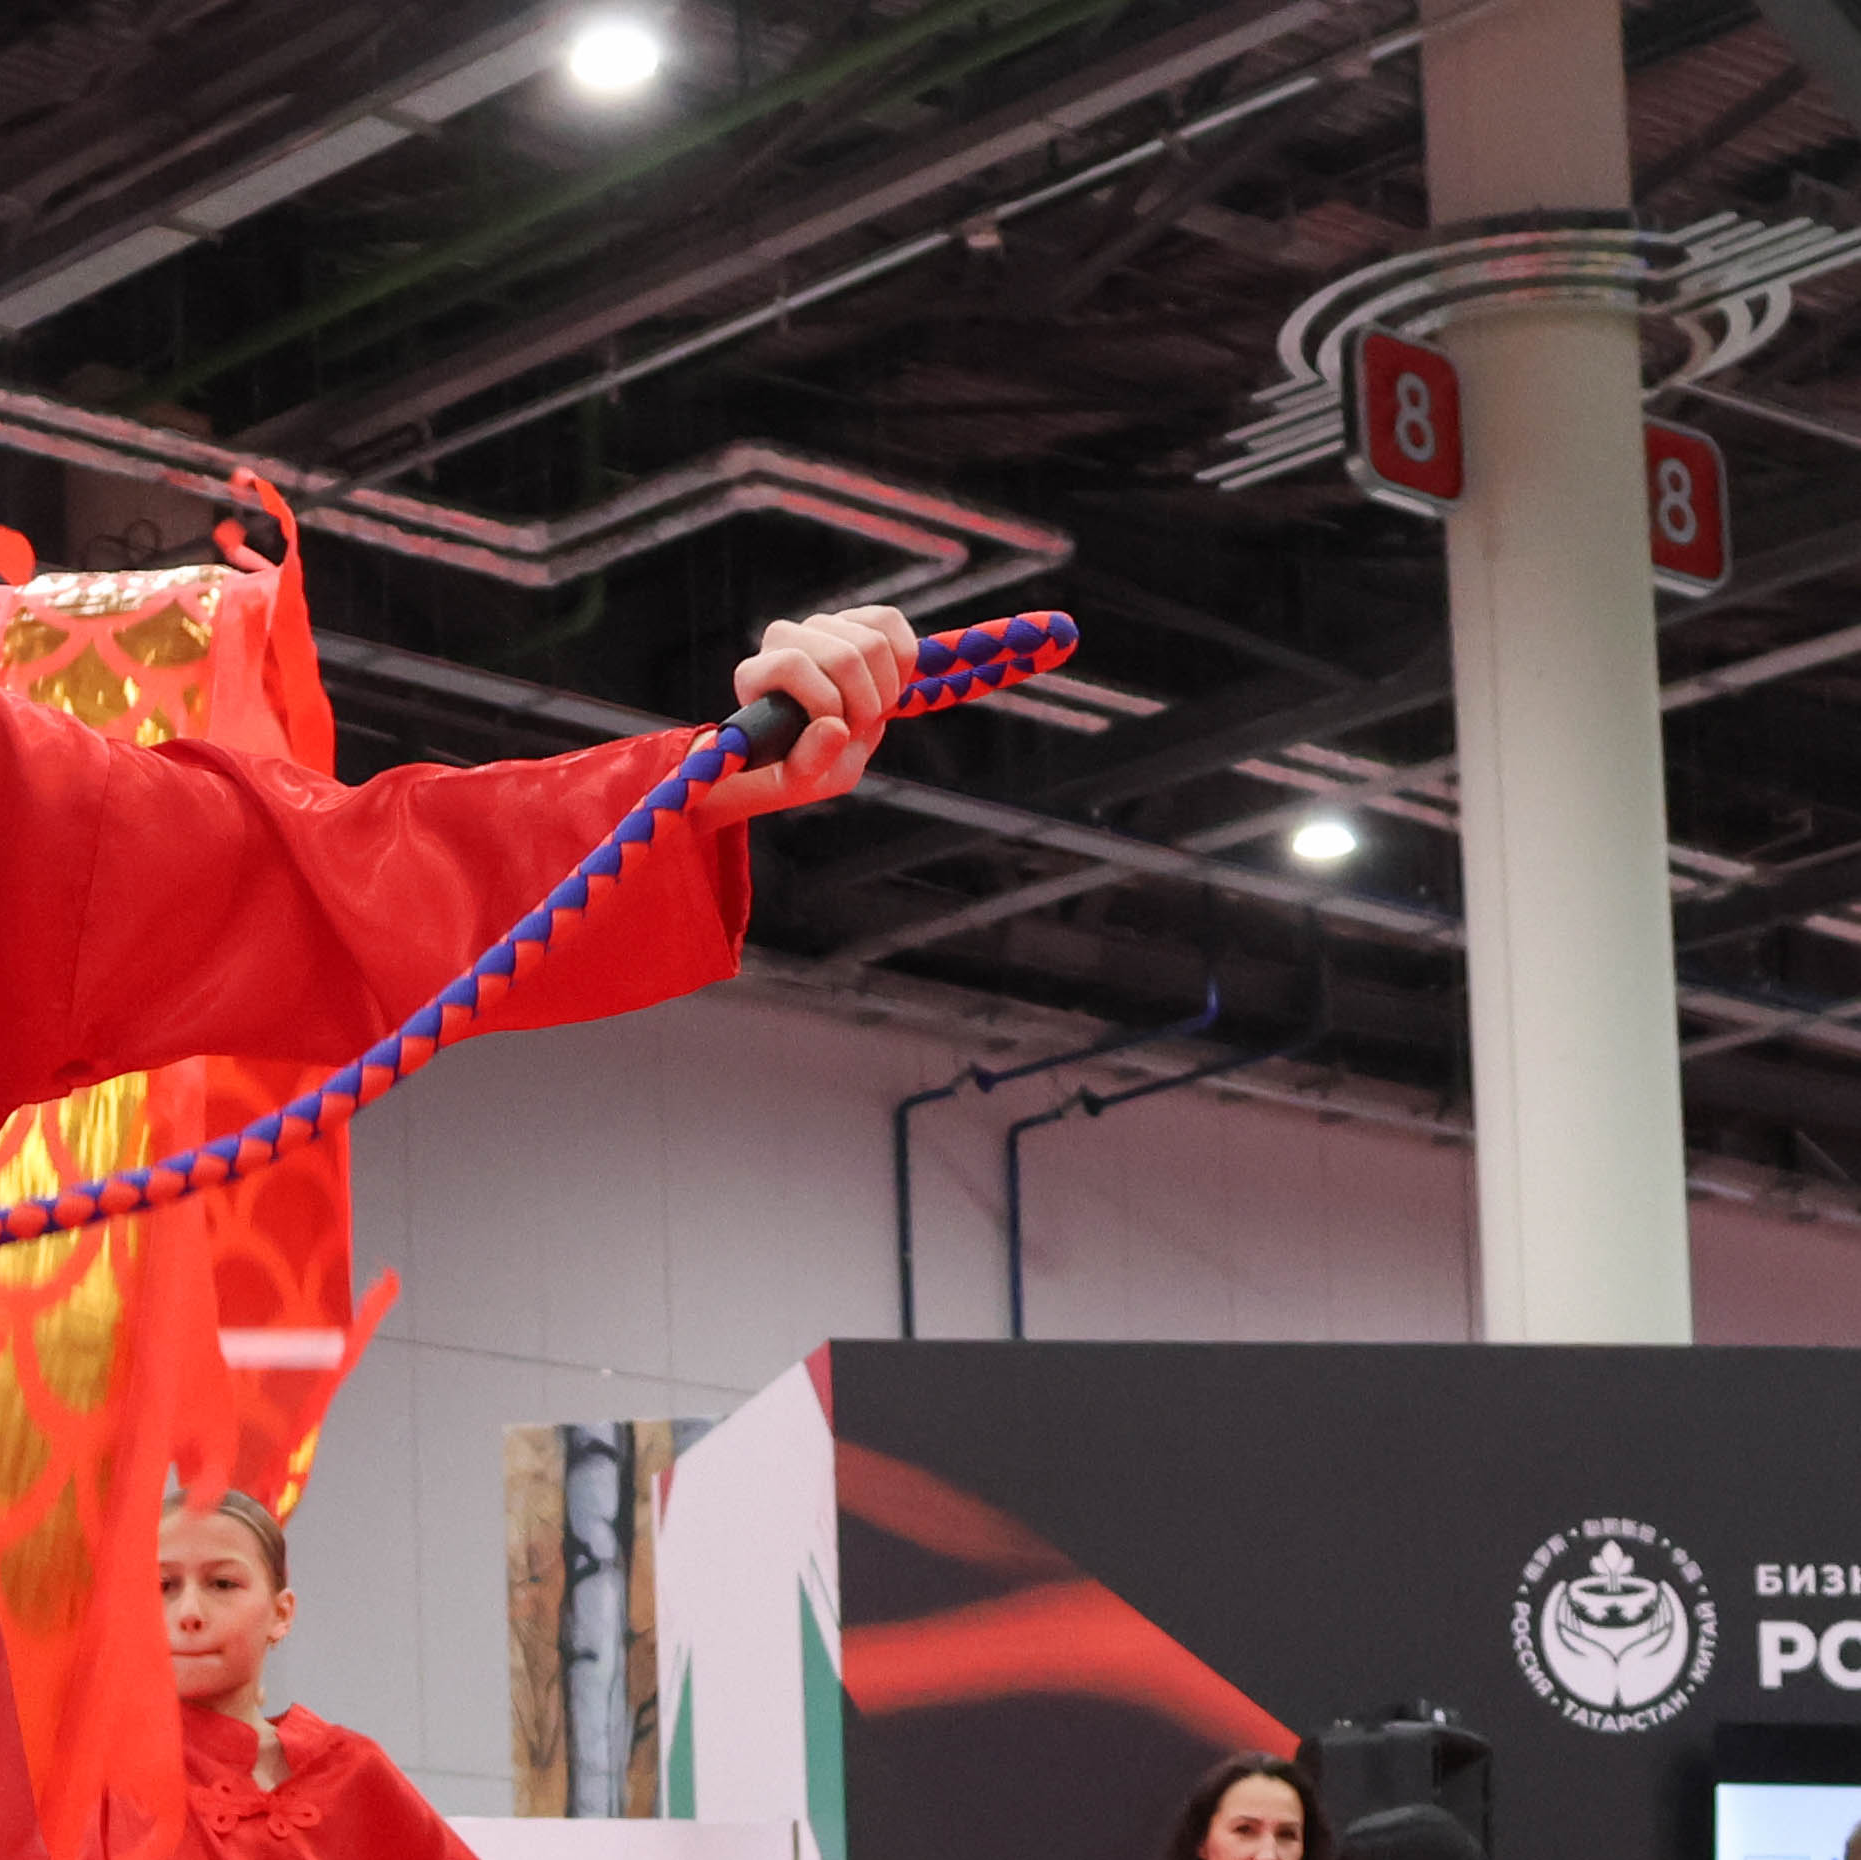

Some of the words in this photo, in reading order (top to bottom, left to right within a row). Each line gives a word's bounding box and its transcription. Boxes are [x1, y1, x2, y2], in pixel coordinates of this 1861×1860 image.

[1395, 372, 1435, 462] 8
[1659, 457, 1697, 544] 8
[1511, 1600, 1555, 1697] РОССИЯ
[1562, 1689, 1690, 1732] ТАТАРСТАН
[1688, 1601, 1719, 1685] КИТАЙ
